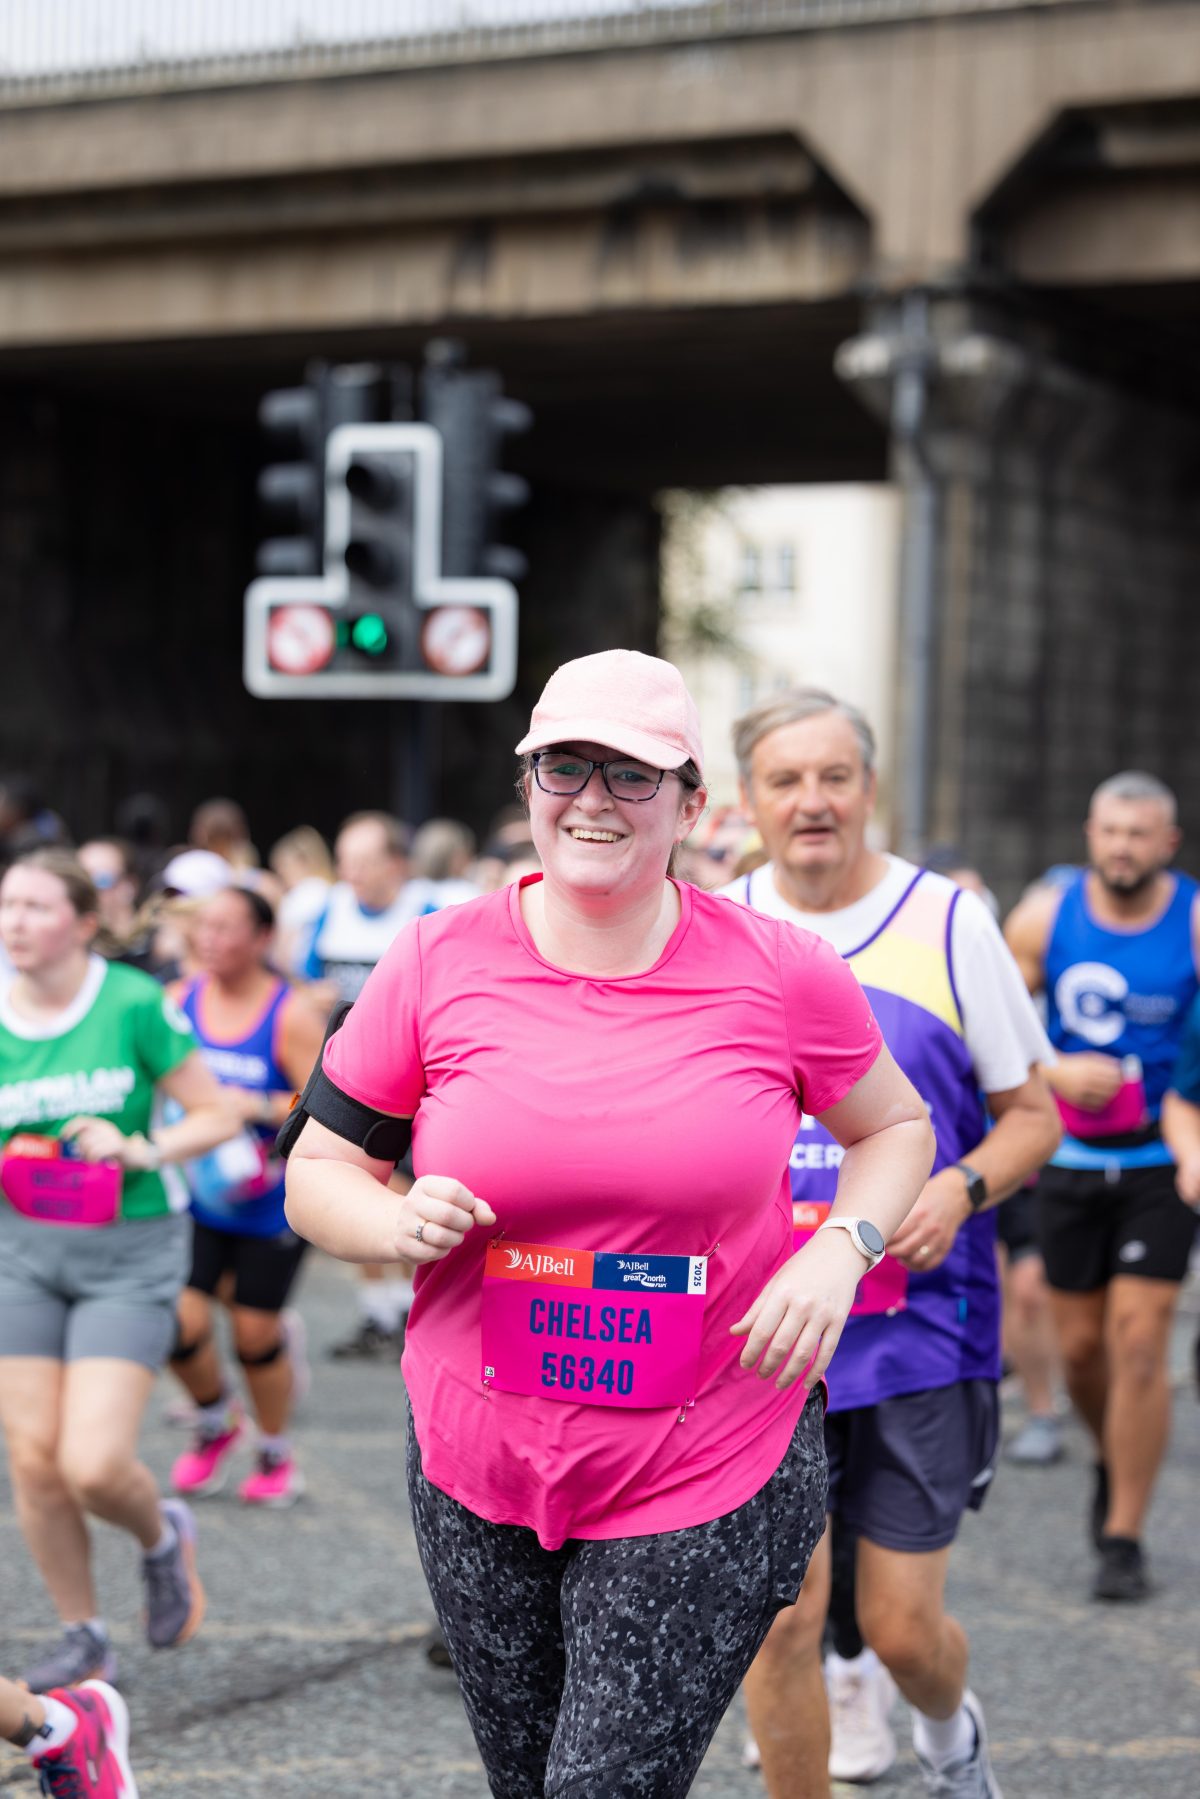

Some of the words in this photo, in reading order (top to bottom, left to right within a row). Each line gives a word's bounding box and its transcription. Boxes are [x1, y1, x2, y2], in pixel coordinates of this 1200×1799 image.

[789, 1143, 845, 1169] CER
[623, 1274, 641, 1282] great
[694, 1264, 703, 1287] 2025
[529, 1298, 653, 1345] CHELSEA
[541, 1352, 634, 1396] 56340
